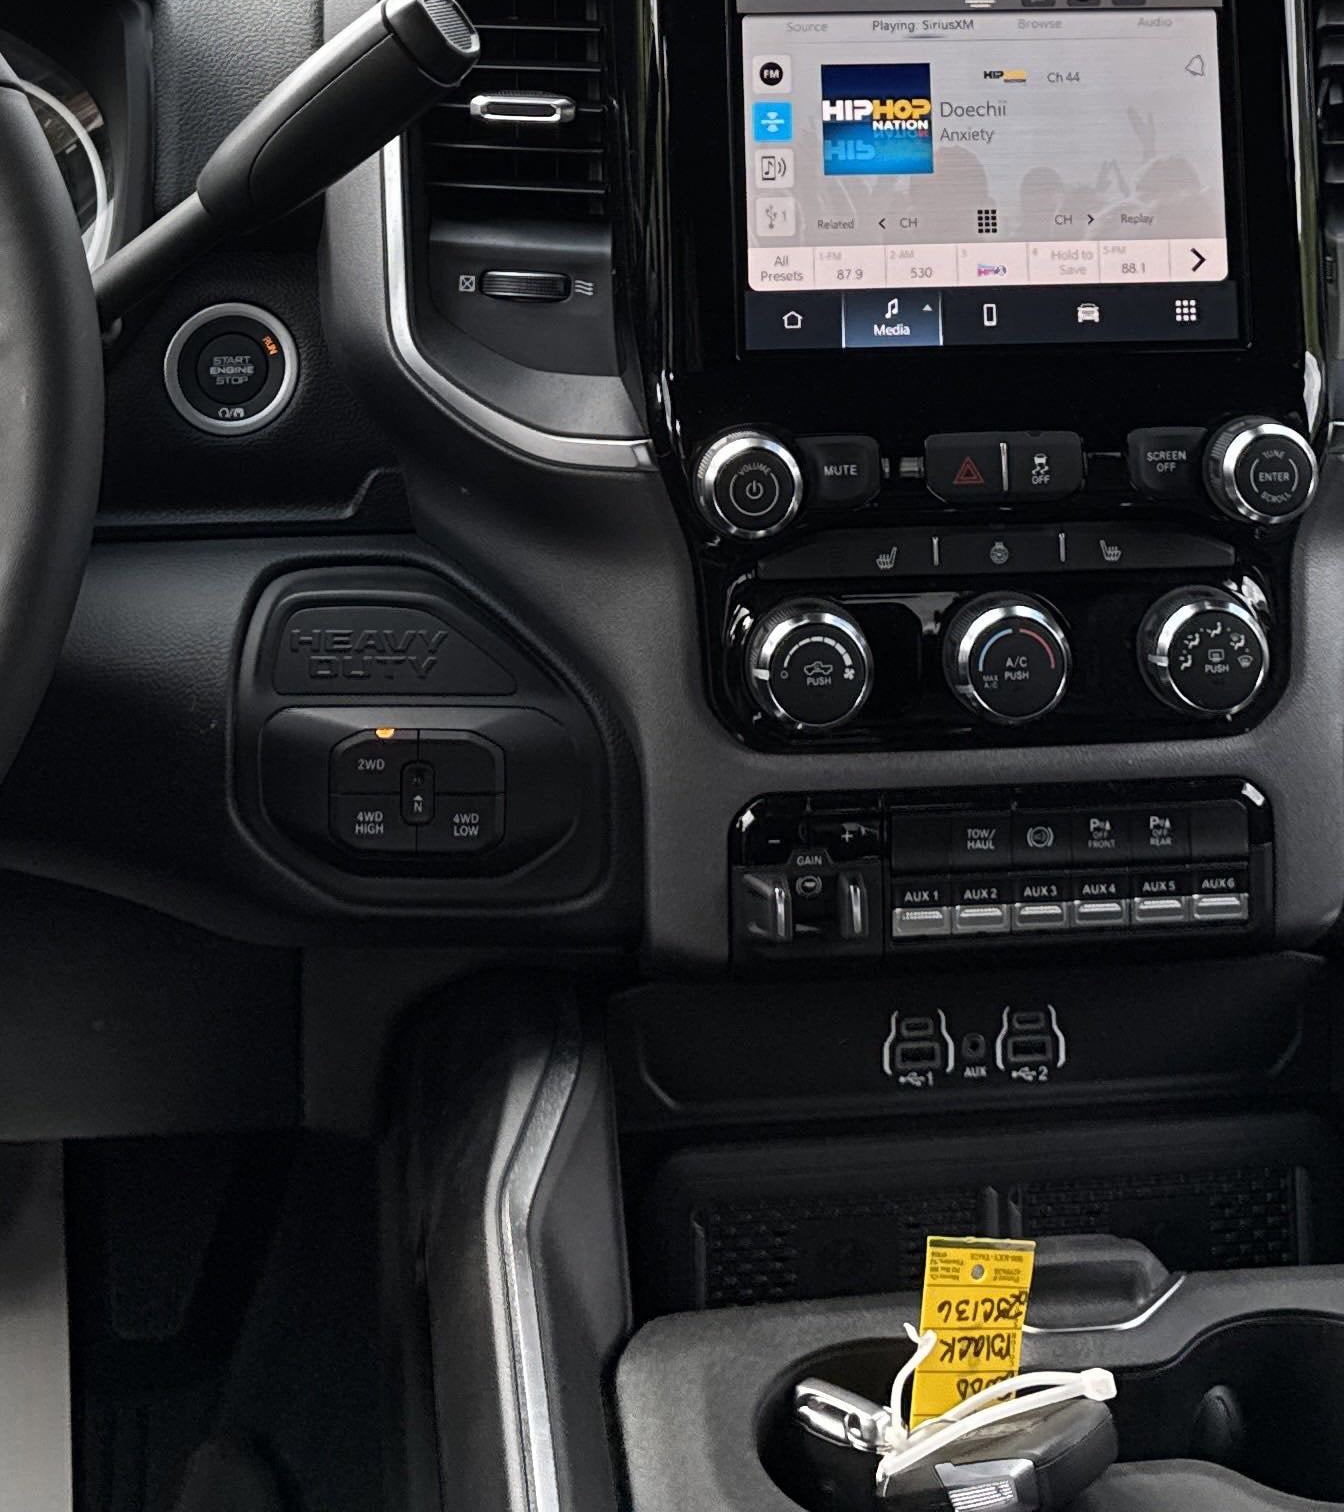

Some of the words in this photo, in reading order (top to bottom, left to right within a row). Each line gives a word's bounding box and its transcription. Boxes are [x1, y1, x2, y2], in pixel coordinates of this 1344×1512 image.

[785, 20, 829, 33] Source
[922, 18, 974, 32] SiriusXM
[1017, 17, 1063, 30] Browse
[1136, 16, 1173, 29] Audio
[763, 68, 780, 80] FM
[983, 70, 1004, 81] HIP
[1046, 71, 1062, 83] Ch
[1065, 71, 1080, 83] 44
[939, 101, 1008, 118] Doechii
[872, 119, 929, 132] NATION
[939, 127, 995, 144] Anxiety
[817, 217, 855, 231] Related
[899, 216, 918, 229] CH
[1054, 213, 1074, 226] CH
[1120, 212, 1155, 227] Replay
[774, 255, 789, 268] All
[1051, 249, 1077, 262] Hold
[1080, 250, 1094, 262] to
[759, 269, 804, 284] Presets
[910, 266, 934, 279] 530
[1059, 264, 1088, 276] Save
[873, 322, 911, 337] Media
[262, 336, 277, 356] RUN
[212, 355, 252, 365] START
[209, 365, 255, 375] ENGINE
[215, 375, 249, 385] STOP
[1146, 448, 1187, 462] SCREEN
[1261, 449, 1287, 461] TUNE
[738, 462, 771, 478] VOLUME
[824, 463, 858, 477] MUTE
[1155, 459, 1177, 473] OFF
[1031, 472, 1051, 485] OFF
[1258, 471, 1290, 483] ENTER
[1258, 487, 1293, 504] SCROLL
[290, 629, 449, 655] HEAVY
[308, 656, 438, 681] DUTY
[1005, 656, 1028, 669] A/C
[1204, 663, 1230, 674] PUSH
[806, 676, 832, 687] PUSH
[982, 674, 999, 683] MAX
[1004, 669, 1029, 681] PUSH
[357, 758, 385, 771] 2WD
[413, 801, 423, 813] N
[356, 811, 384, 823] 4WD
[452, 813, 479, 825] 4WD
[355, 822, 385, 835] HIGH
[453, 824, 479, 837] LOW
[966, 828, 996, 842] TOW/
[1151, 828, 1168, 837] OFF
[1091, 831, 1109, 840] OFF
[1149, 836, 1172, 846] REAR
[966, 839, 995, 851] HAUL
[1087, 839, 1116, 849] FRONT
[796, 855, 822, 866] GAIN
[1082, 883, 1107, 895] AUX
[1108, 883, 1117, 895] 4
[1142, 881, 1166, 892] AUX
[1168, 881, 1176, 892] 5
[1201, 877, 1226, 890] AUX
[1226, 877, 1235, 889] 6
[903, 890, 928, 901] AUX
[931, 890, 939, 901] 1
[963, 888, 988, 899] AUX
[990, 888, 998, 899] 2
[1023, 885, 1048, 896] AUX
[1050, 885, 1058, 897] 3
[964, 1066, 987, 1078] AUX
[1038, 1067, 1049, 1081] 2
[927, 1073, 934, 1085] 1
[939, 1333, 1011, 1363] Black
